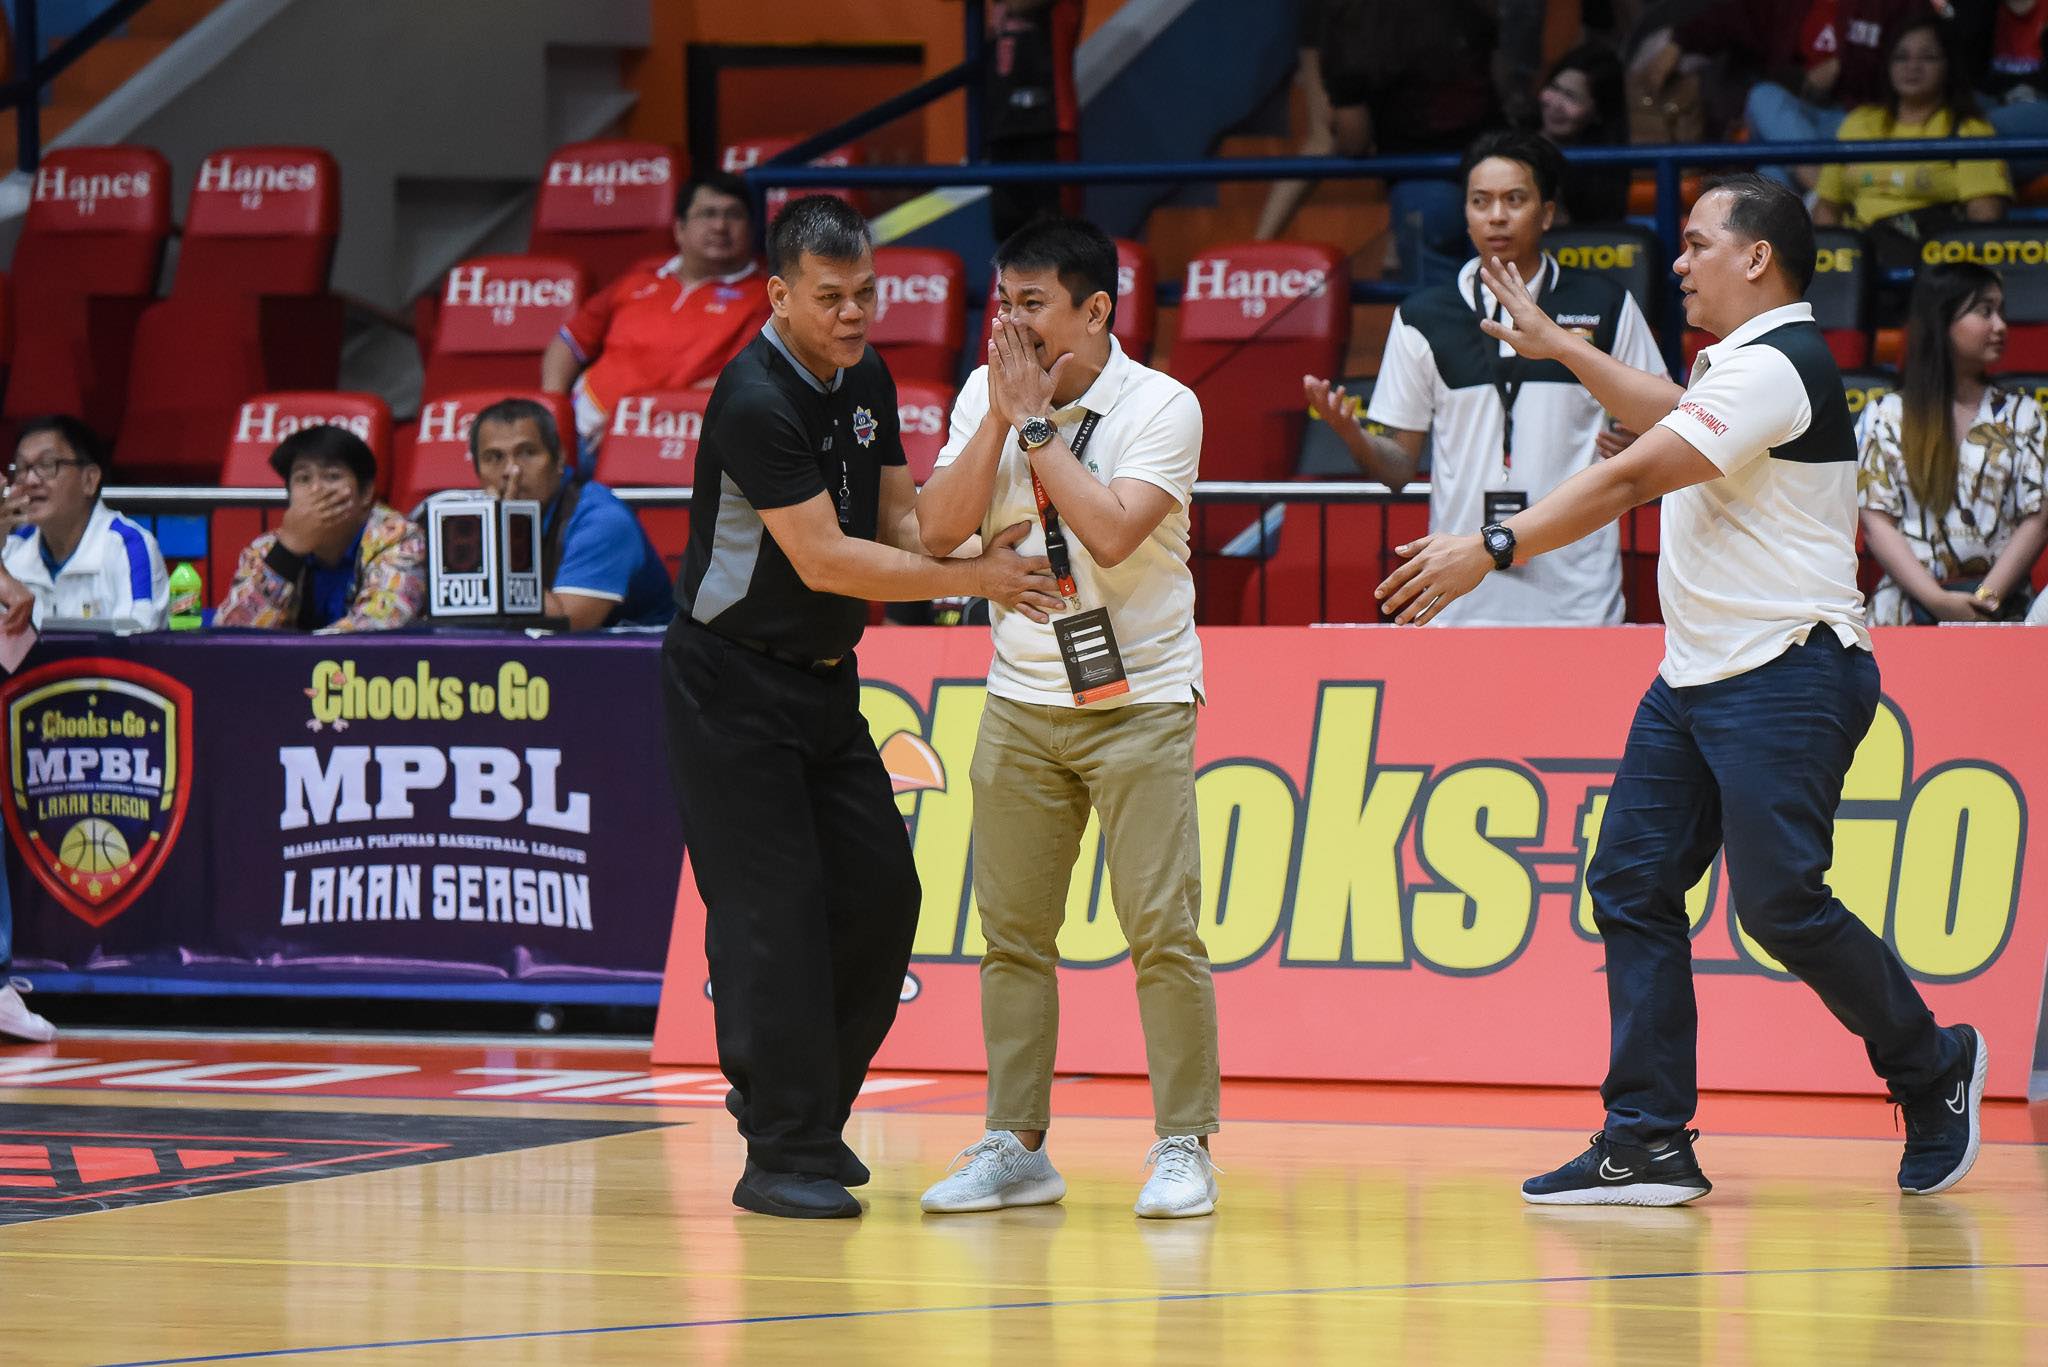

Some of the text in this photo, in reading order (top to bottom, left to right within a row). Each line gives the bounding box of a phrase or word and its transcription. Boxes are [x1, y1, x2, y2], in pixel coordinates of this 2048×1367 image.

[34, 166, 151, 201] Hanes
[198, 157, 319, 193] Hanes
[1558, 244, 1634, 271] DTOE
[1921, 239, 2048, 266] GOLDTO
[446, 266, 576, 307] Hanes
[876, 274, 951, 304] nes
[1184, 258, 1328, 301] Hanes
[611, 396, 701, 441] Han
[1694, 407, 1729, 437] PHARMACY
[440, 579, 489, 607] FOUL
[508, 579, 537, 607] FOUL
[312, 659, 550, 723] Chooks to Go
[42, 709, 109, 739] Chooks
[122, 709, 146, 738] Go
[26, 747, 162, 788] MPBL
[279, 745, 591, 834] MPBL
[38, 793, 150, 821] LAKAN SEASON
[283, 832, 587, 864] MAHARLIKA PILIPINAS BASKETBALL LEAGUE
[280, 863, 594, 931] LAKAN SEASON
